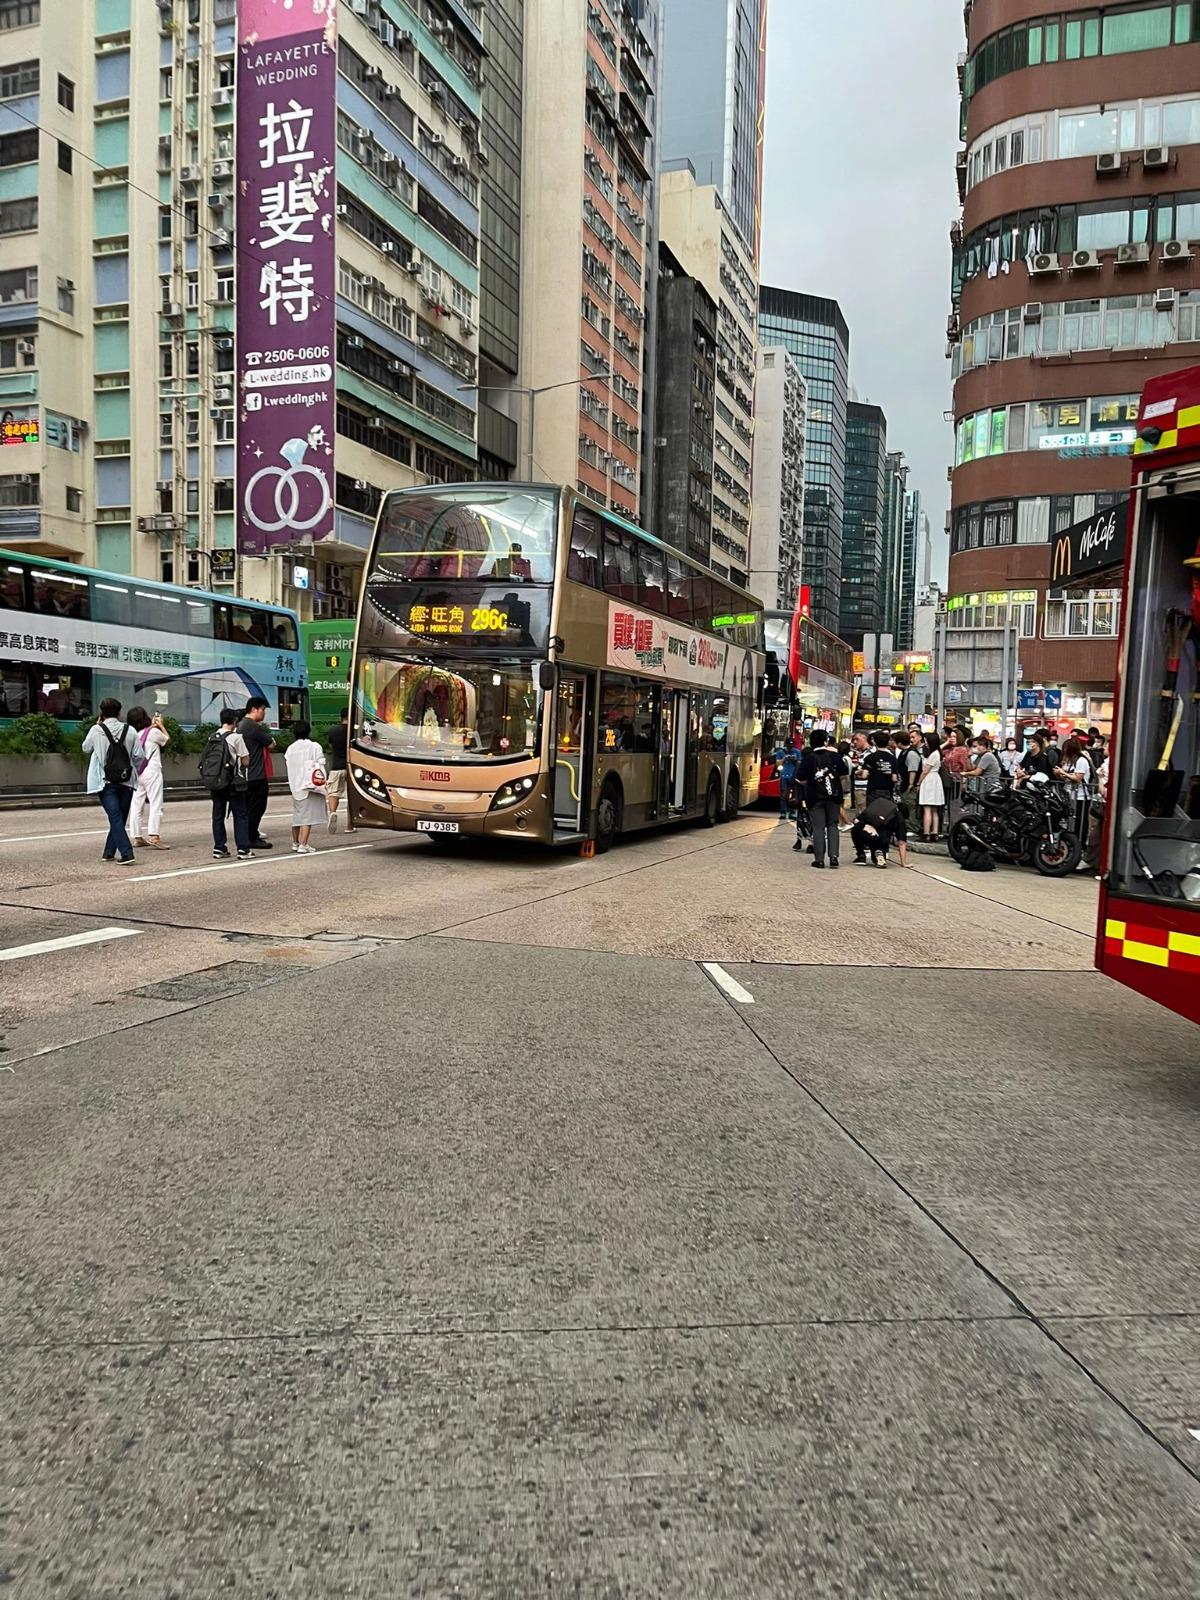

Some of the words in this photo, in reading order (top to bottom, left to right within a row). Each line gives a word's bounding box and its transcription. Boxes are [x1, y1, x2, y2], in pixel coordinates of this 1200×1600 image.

[247, 41, 330, 70] LAFAYETTE
[255, 64, 319, 86] WEDDING
[258, 98, 316, 326] 拉斐特
[264, 345, 330, 364] 2506-0606
[250, 366, 327, 385] L-wedding.hk
[1079, 511, 1116, 561] McCafé
[429, 624, 448, 633] MONG
[449, 624, 463, 633] KOK
[419, 821, 431, 830] TJ
[433, 822, 458, 832] 9385
